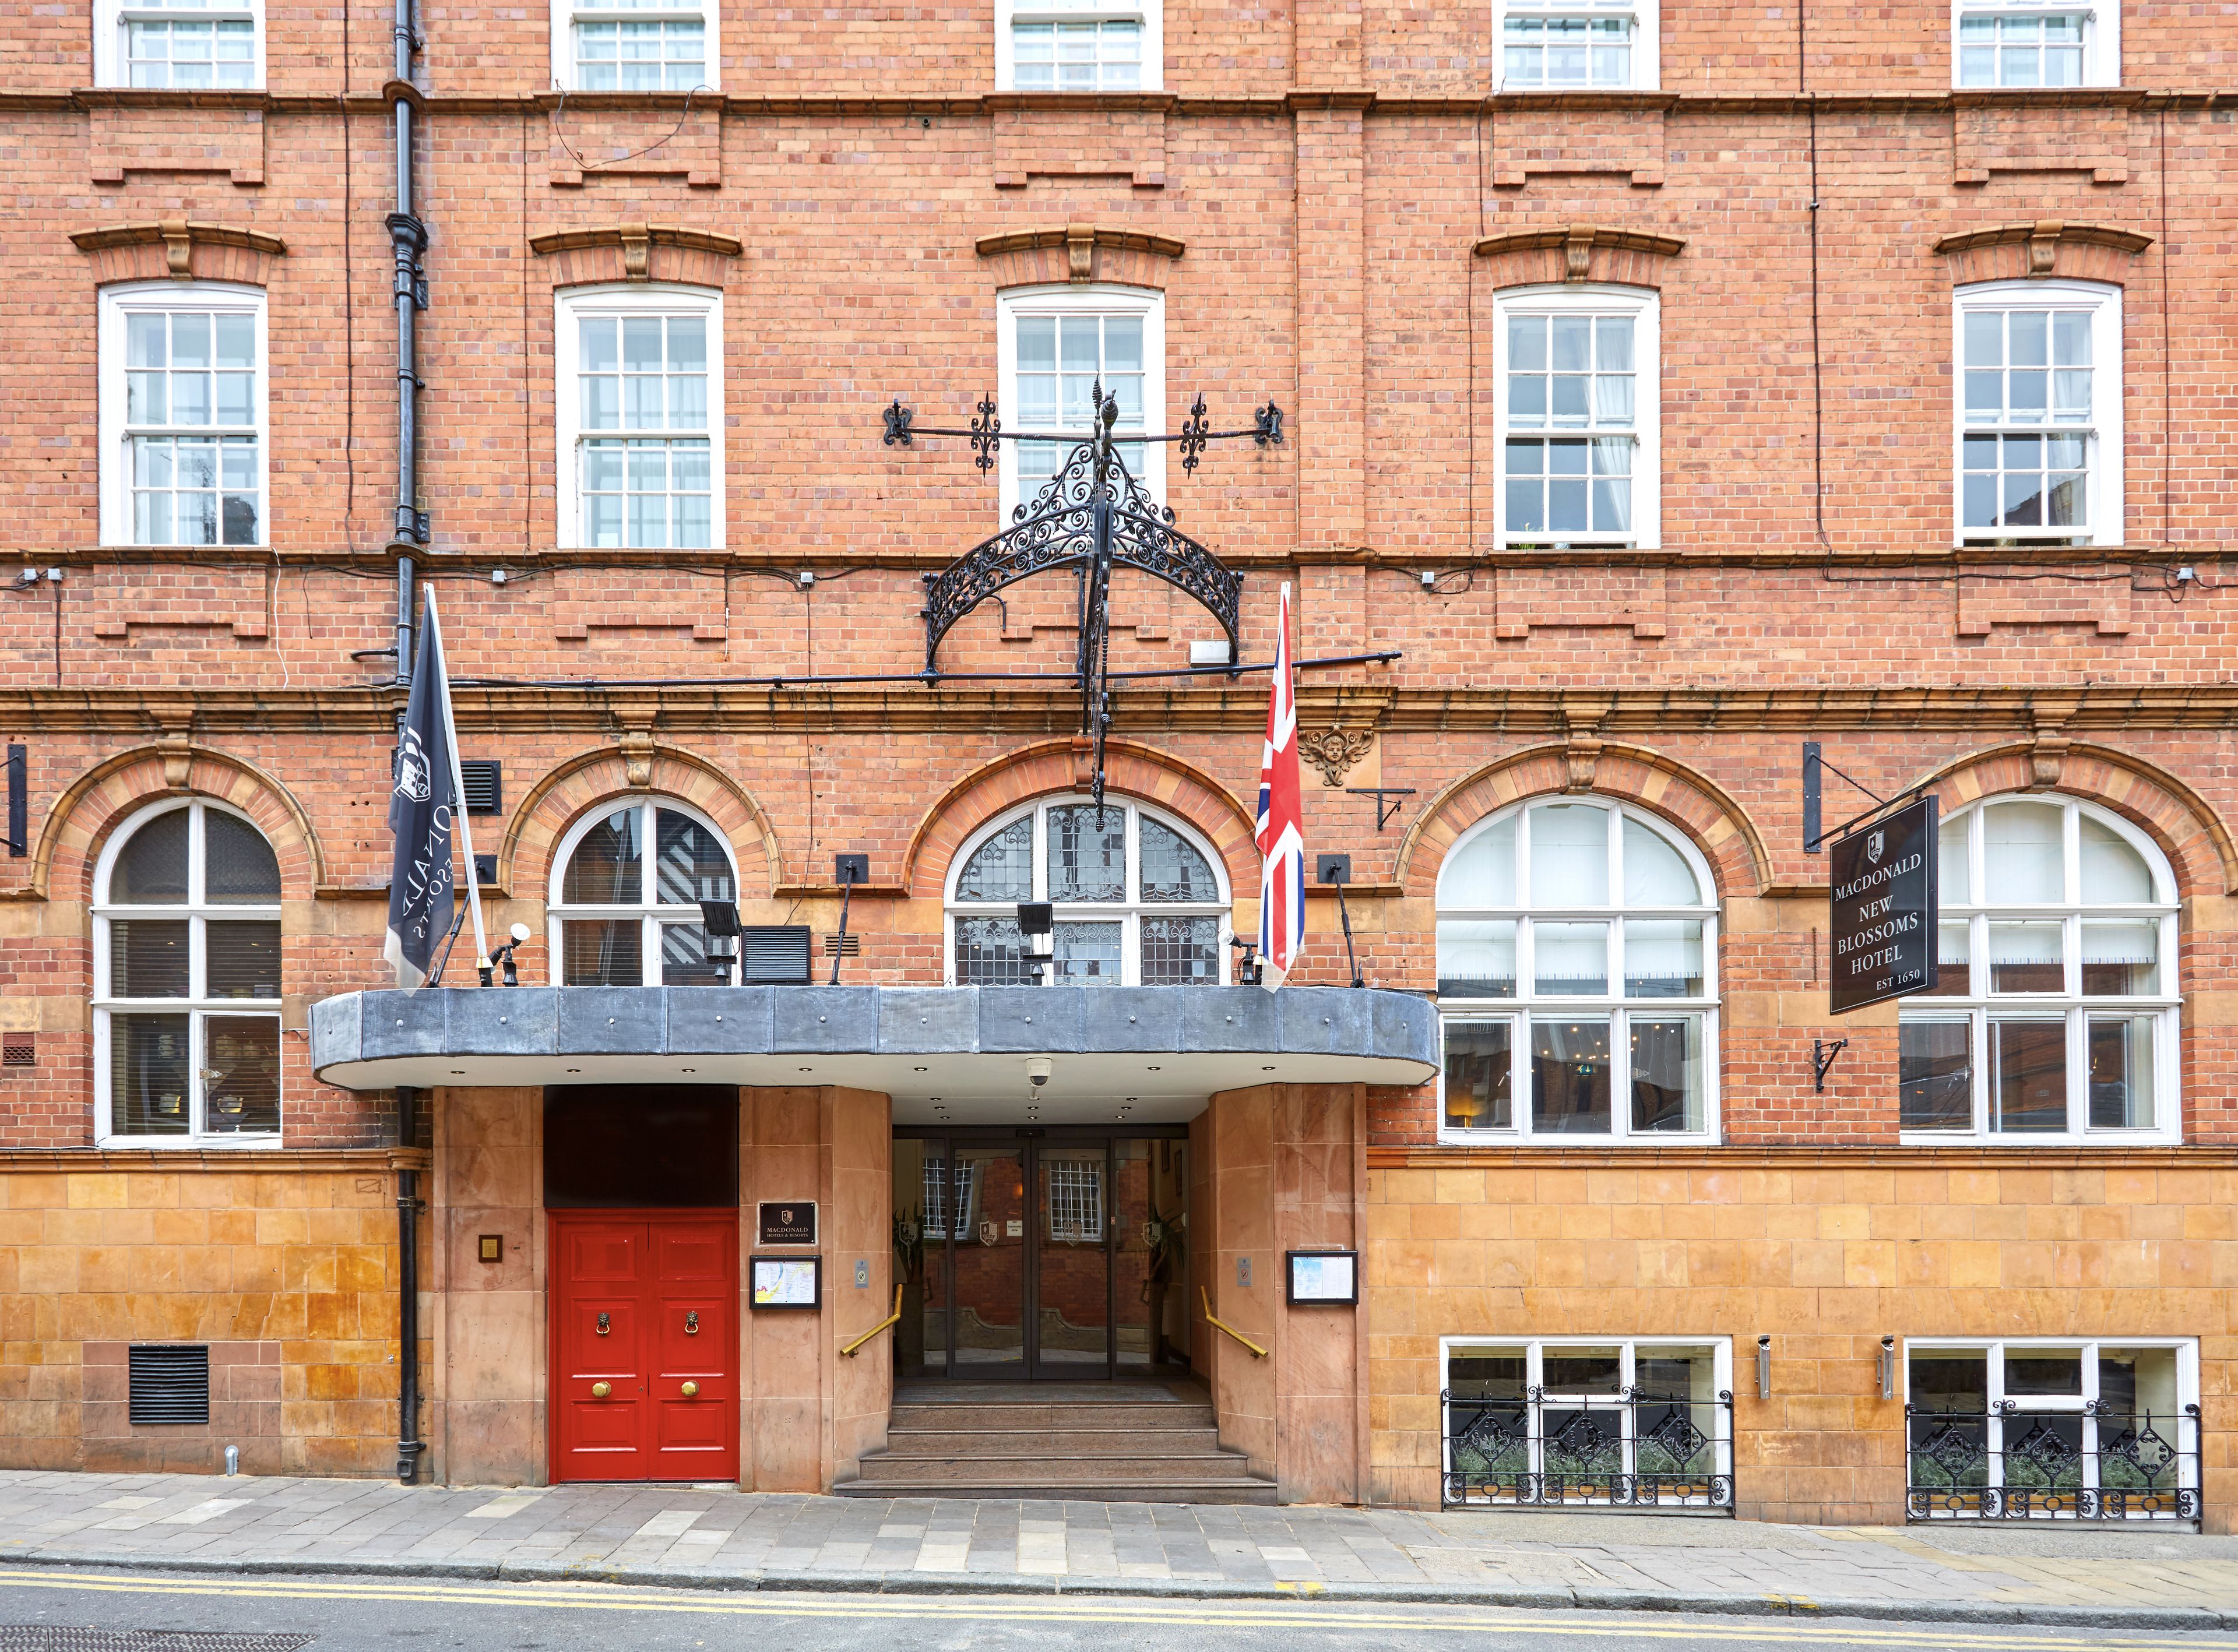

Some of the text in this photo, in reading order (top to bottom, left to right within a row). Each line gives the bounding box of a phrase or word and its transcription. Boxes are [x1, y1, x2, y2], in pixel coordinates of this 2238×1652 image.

[1835, 854, 1921, 901] MACDONALD
[1859, 895, 1894, 922] NEW
[1838, 912, 1918, 955] BLOSSOMS
[1851, 945, 1902, 975] HOTEL
[1876, 968, 1920, 991] EST 1650
